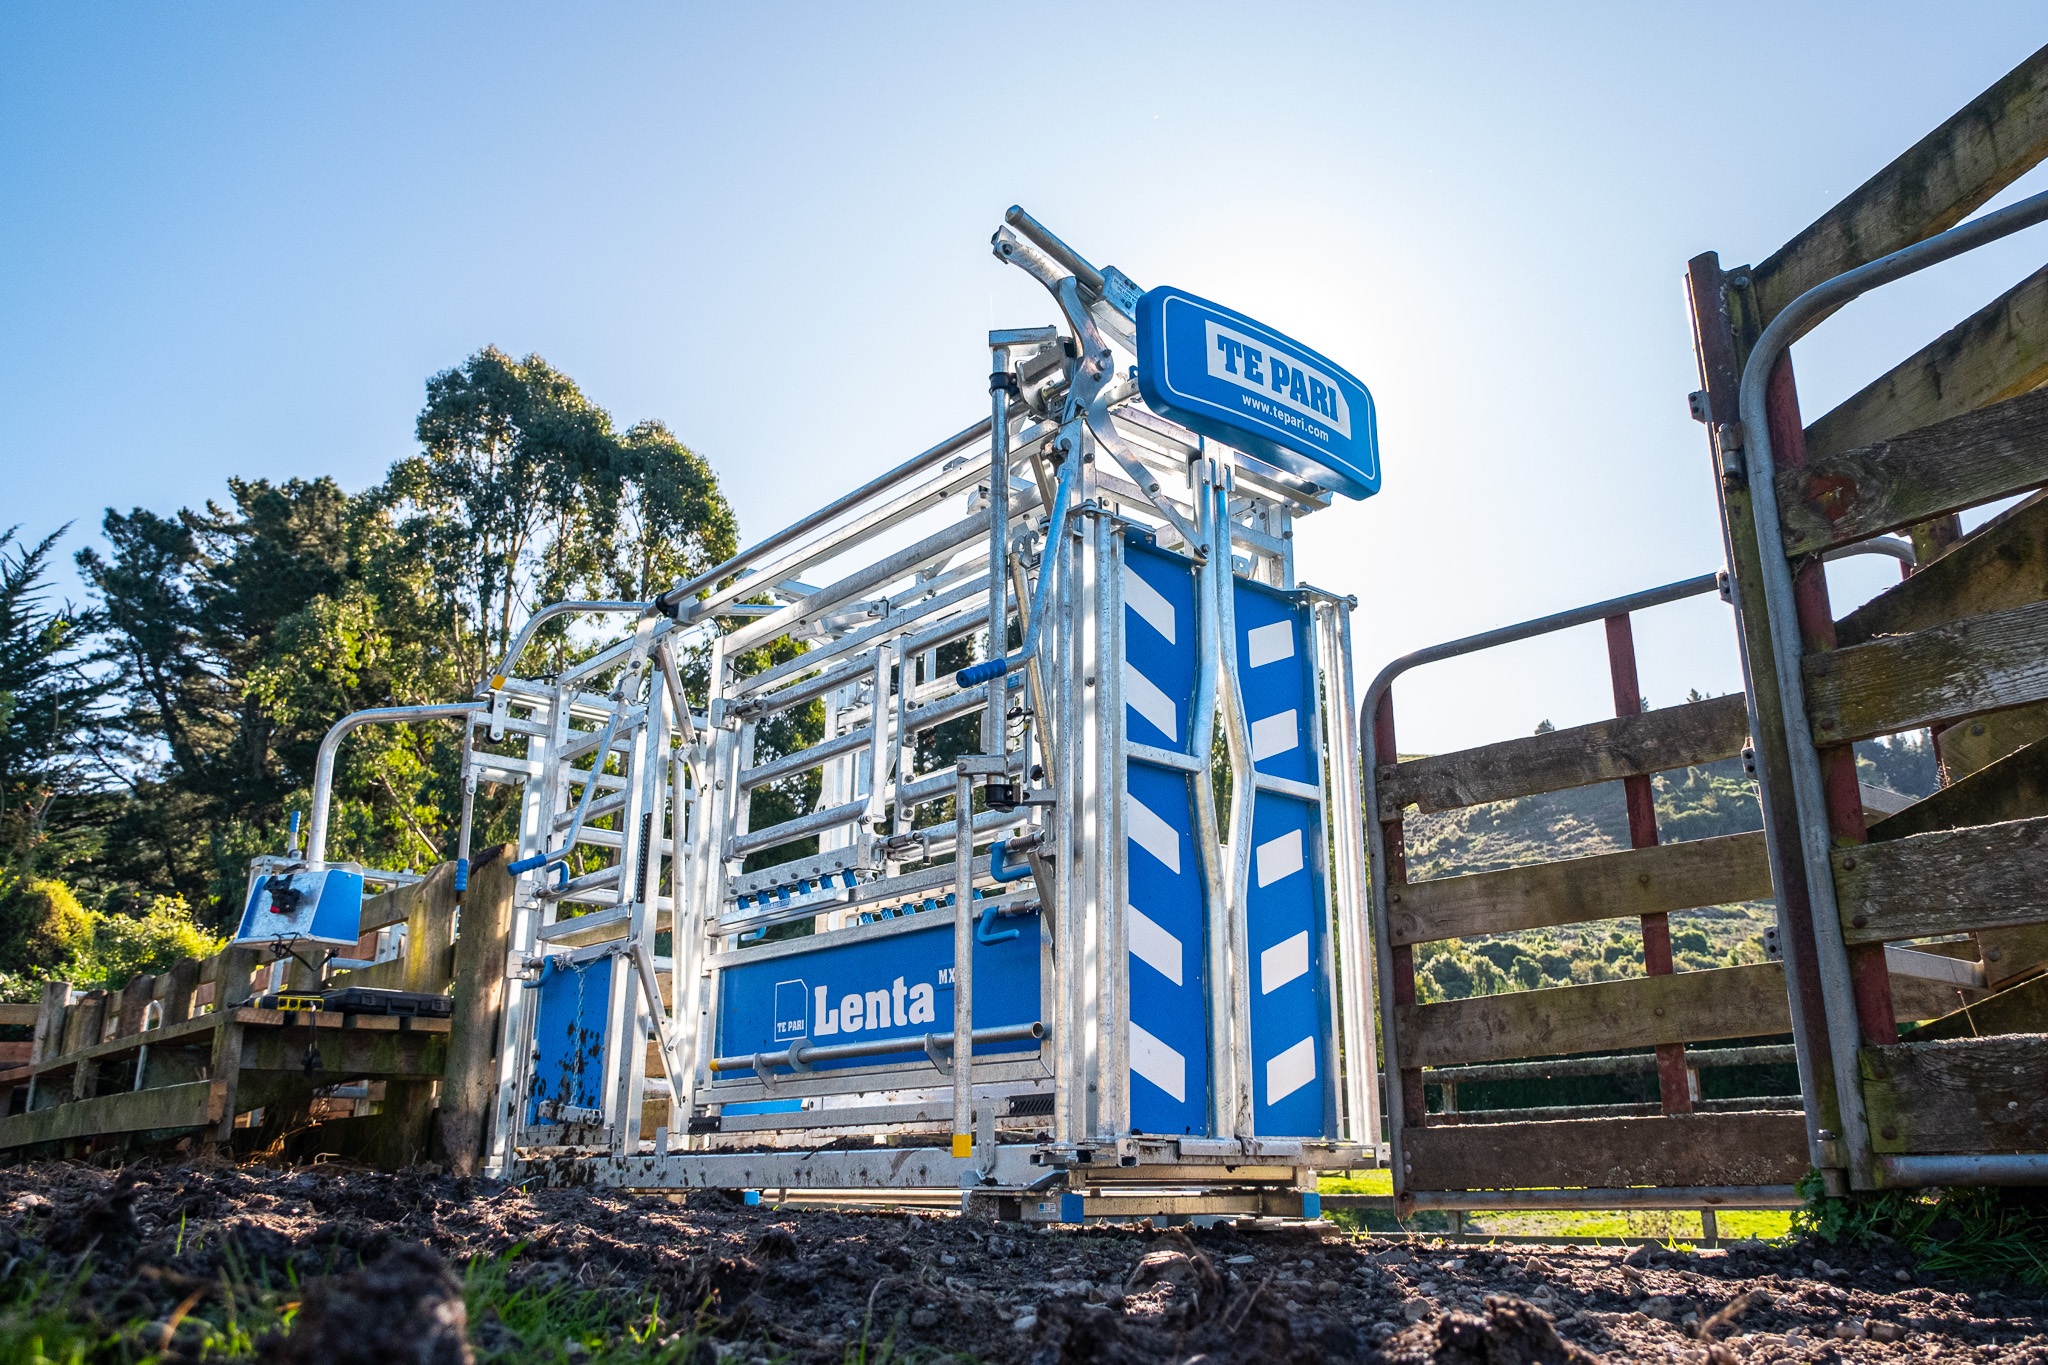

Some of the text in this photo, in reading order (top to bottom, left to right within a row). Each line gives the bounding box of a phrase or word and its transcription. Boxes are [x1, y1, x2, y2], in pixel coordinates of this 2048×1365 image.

[1217, 333, 1339, 423] TE PARI
[1242, 394, 1329, 442] www.tepari.com
[776, 1019, 805, 1033] TE PARI
[814, 975, 936, 1036] Lenta
